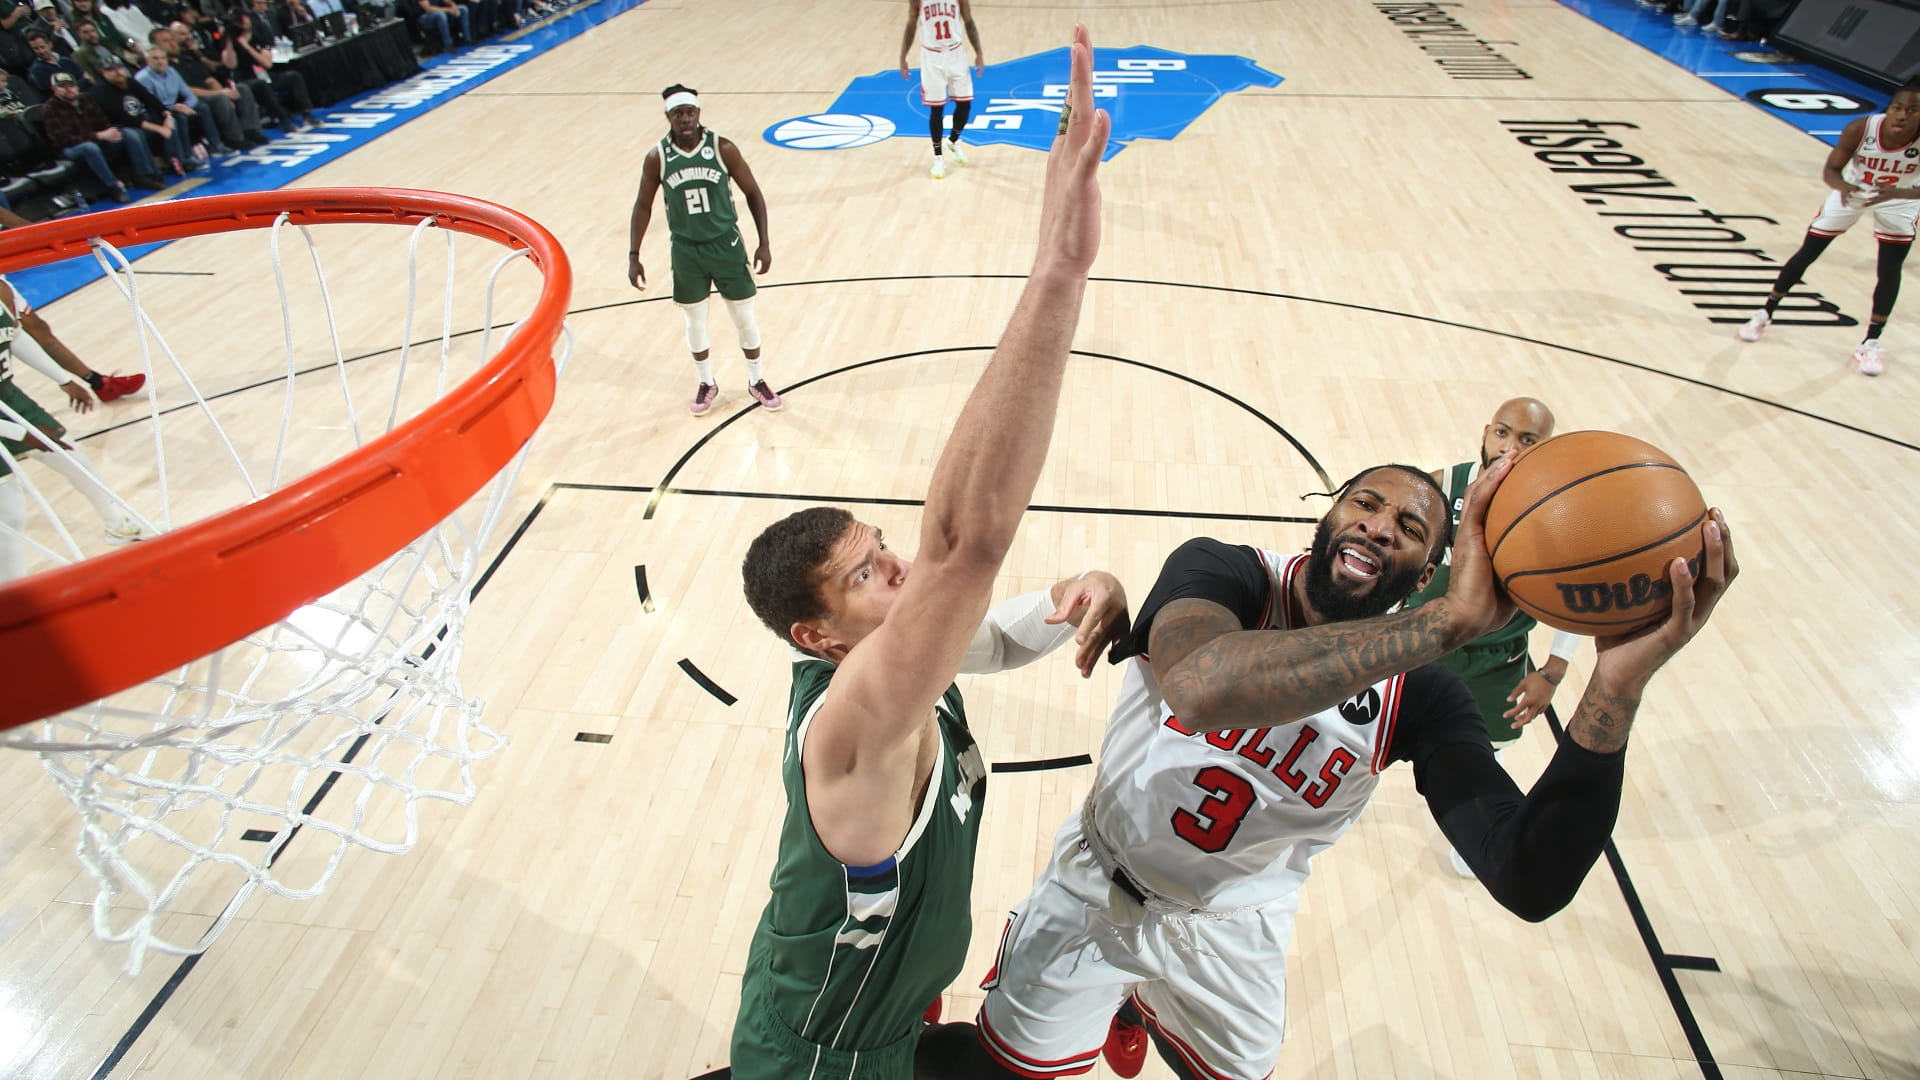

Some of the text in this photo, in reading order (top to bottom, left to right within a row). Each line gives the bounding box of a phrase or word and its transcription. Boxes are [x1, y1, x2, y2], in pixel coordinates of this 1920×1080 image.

[923, 3, 957, 21] BULLS
[934, 20, 952, 40] 11
[665, 166, 722, 190] MILWAUKEE
[684, 187, 711, 215] 21
[1499, 118, 1859, 327] fiserv.forum
[1556, 550, 1702, 614] Wils
[1163, 714, 1362, 810] LLS
[1168, 765, 1258, 854] 3
